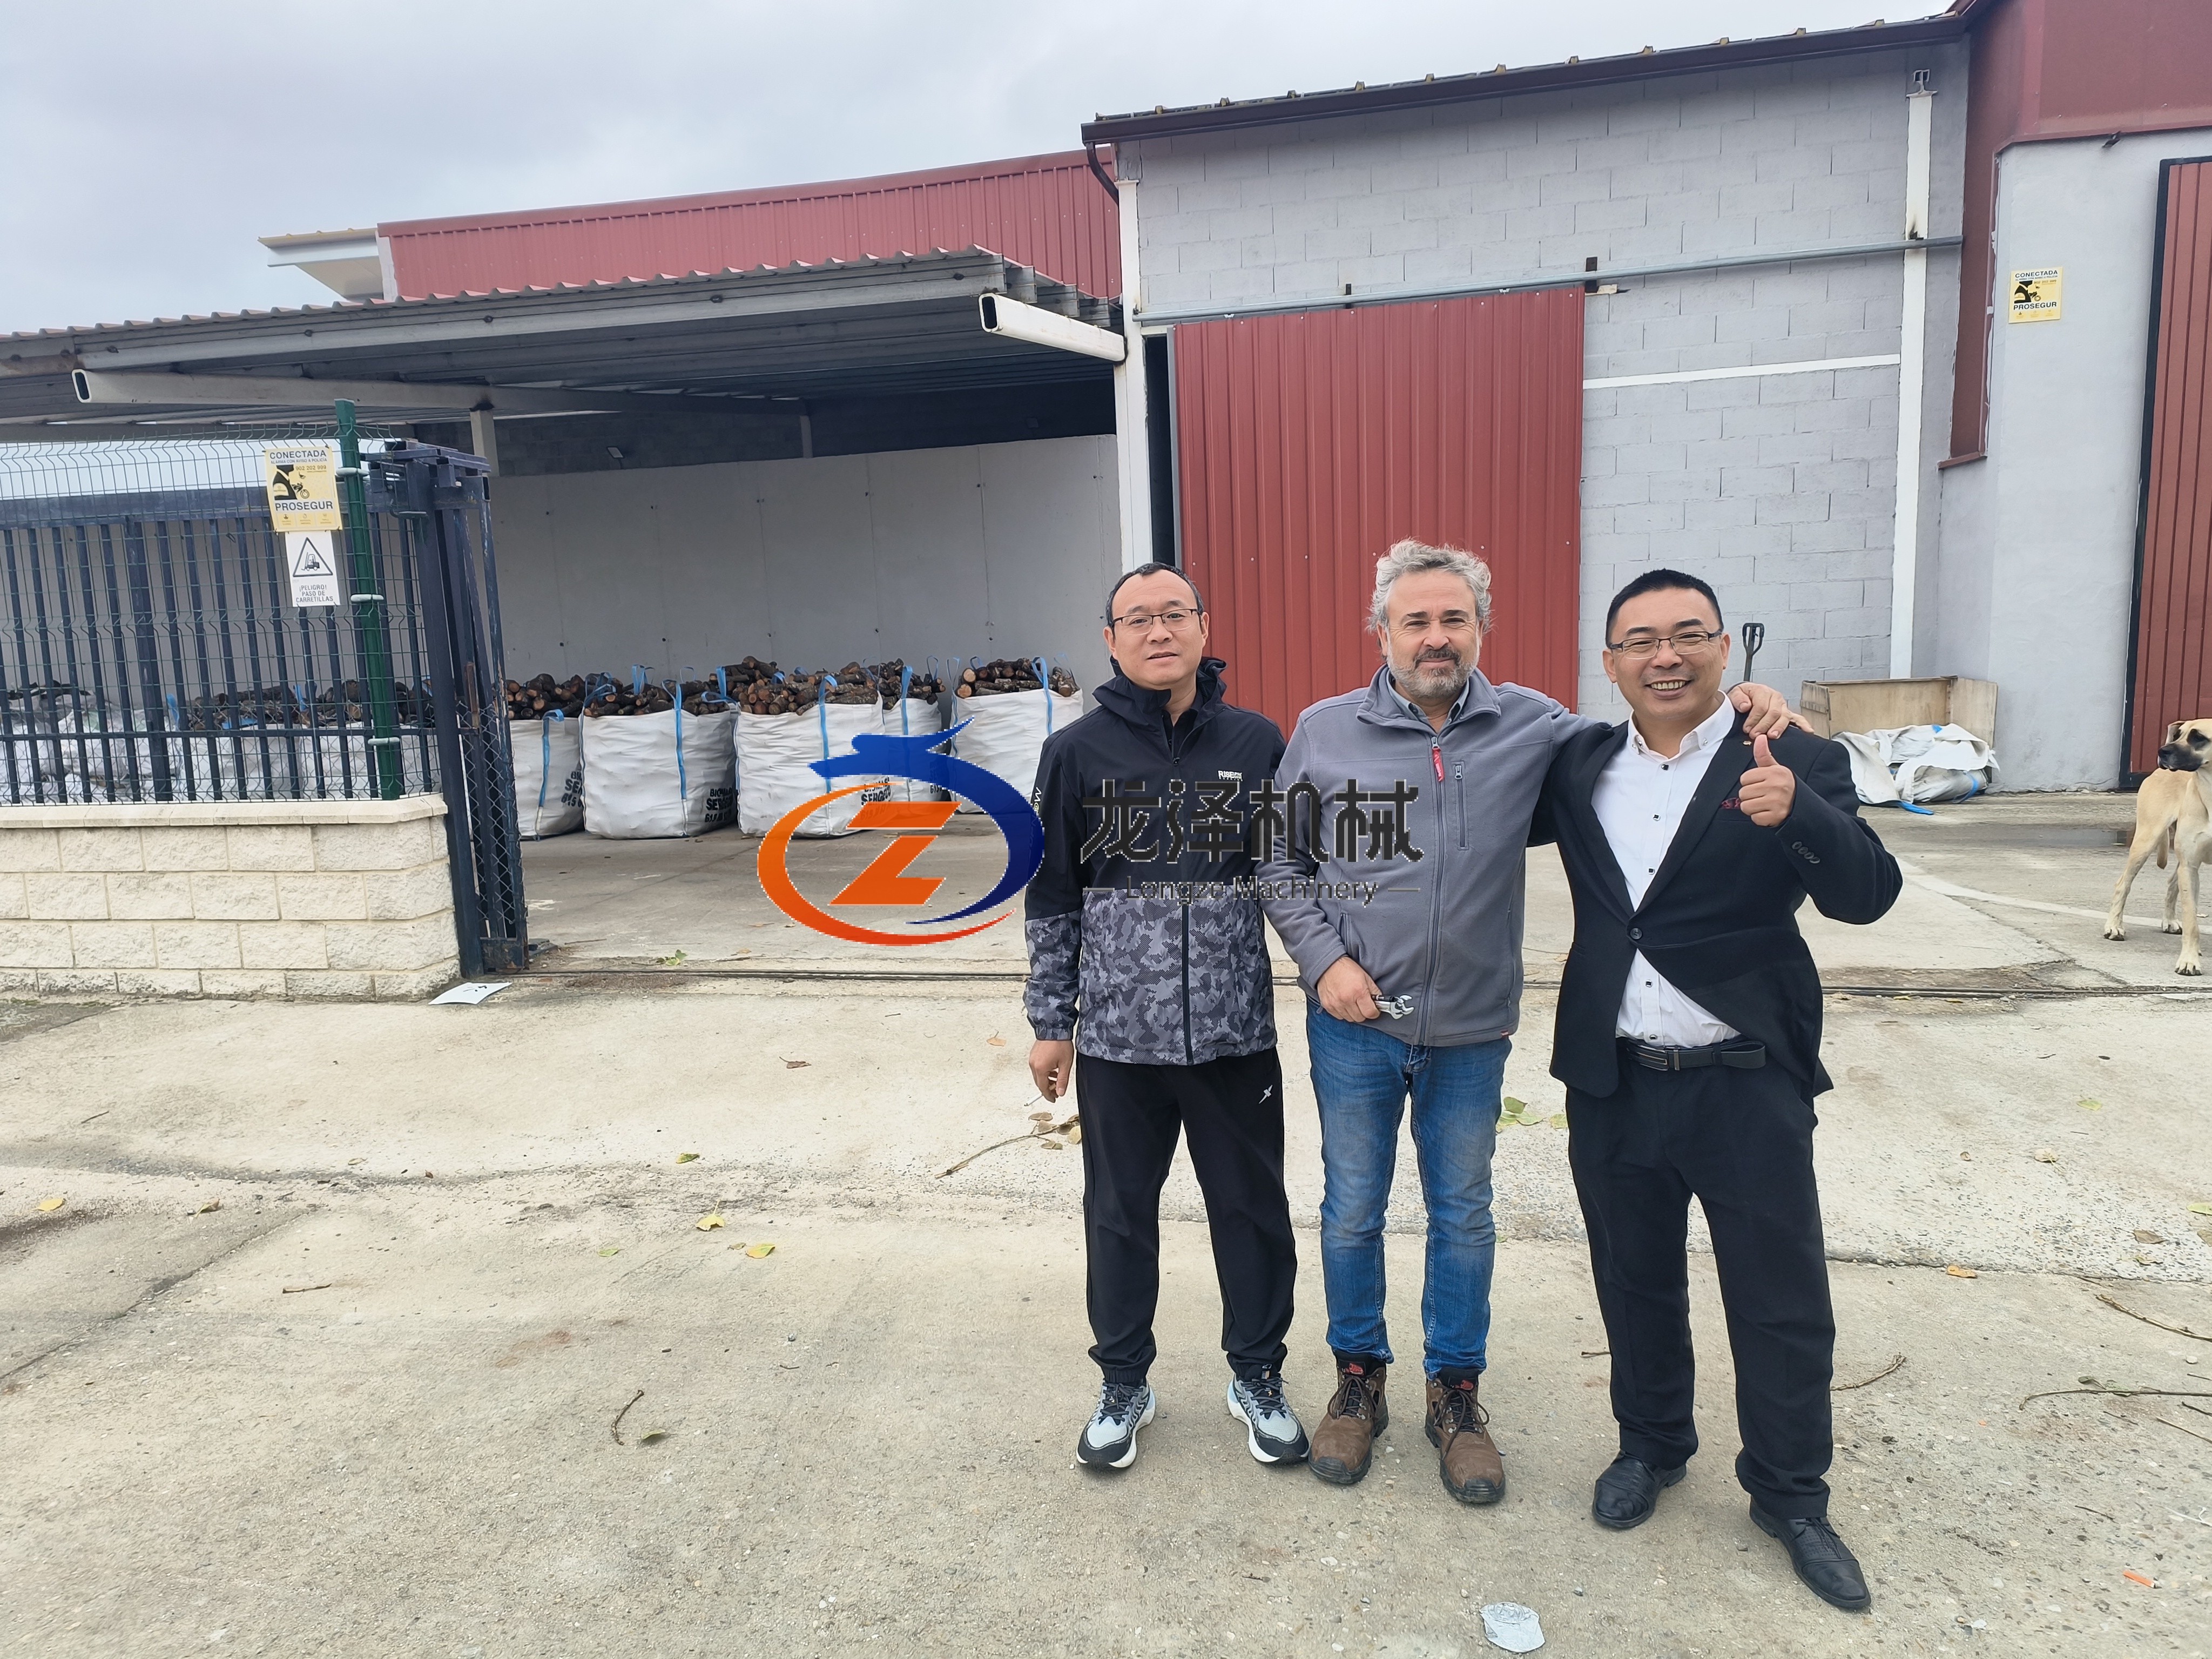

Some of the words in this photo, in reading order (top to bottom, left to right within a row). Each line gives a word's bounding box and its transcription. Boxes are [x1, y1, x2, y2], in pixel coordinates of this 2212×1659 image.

[2015, 270, 2058, 278] CONECTADA
[2014, 302, 2057, 310] PROSEGUR
[269, 450, 327, 459] CONECTADA
[275, 501, 333, 511] PROSEGUR
